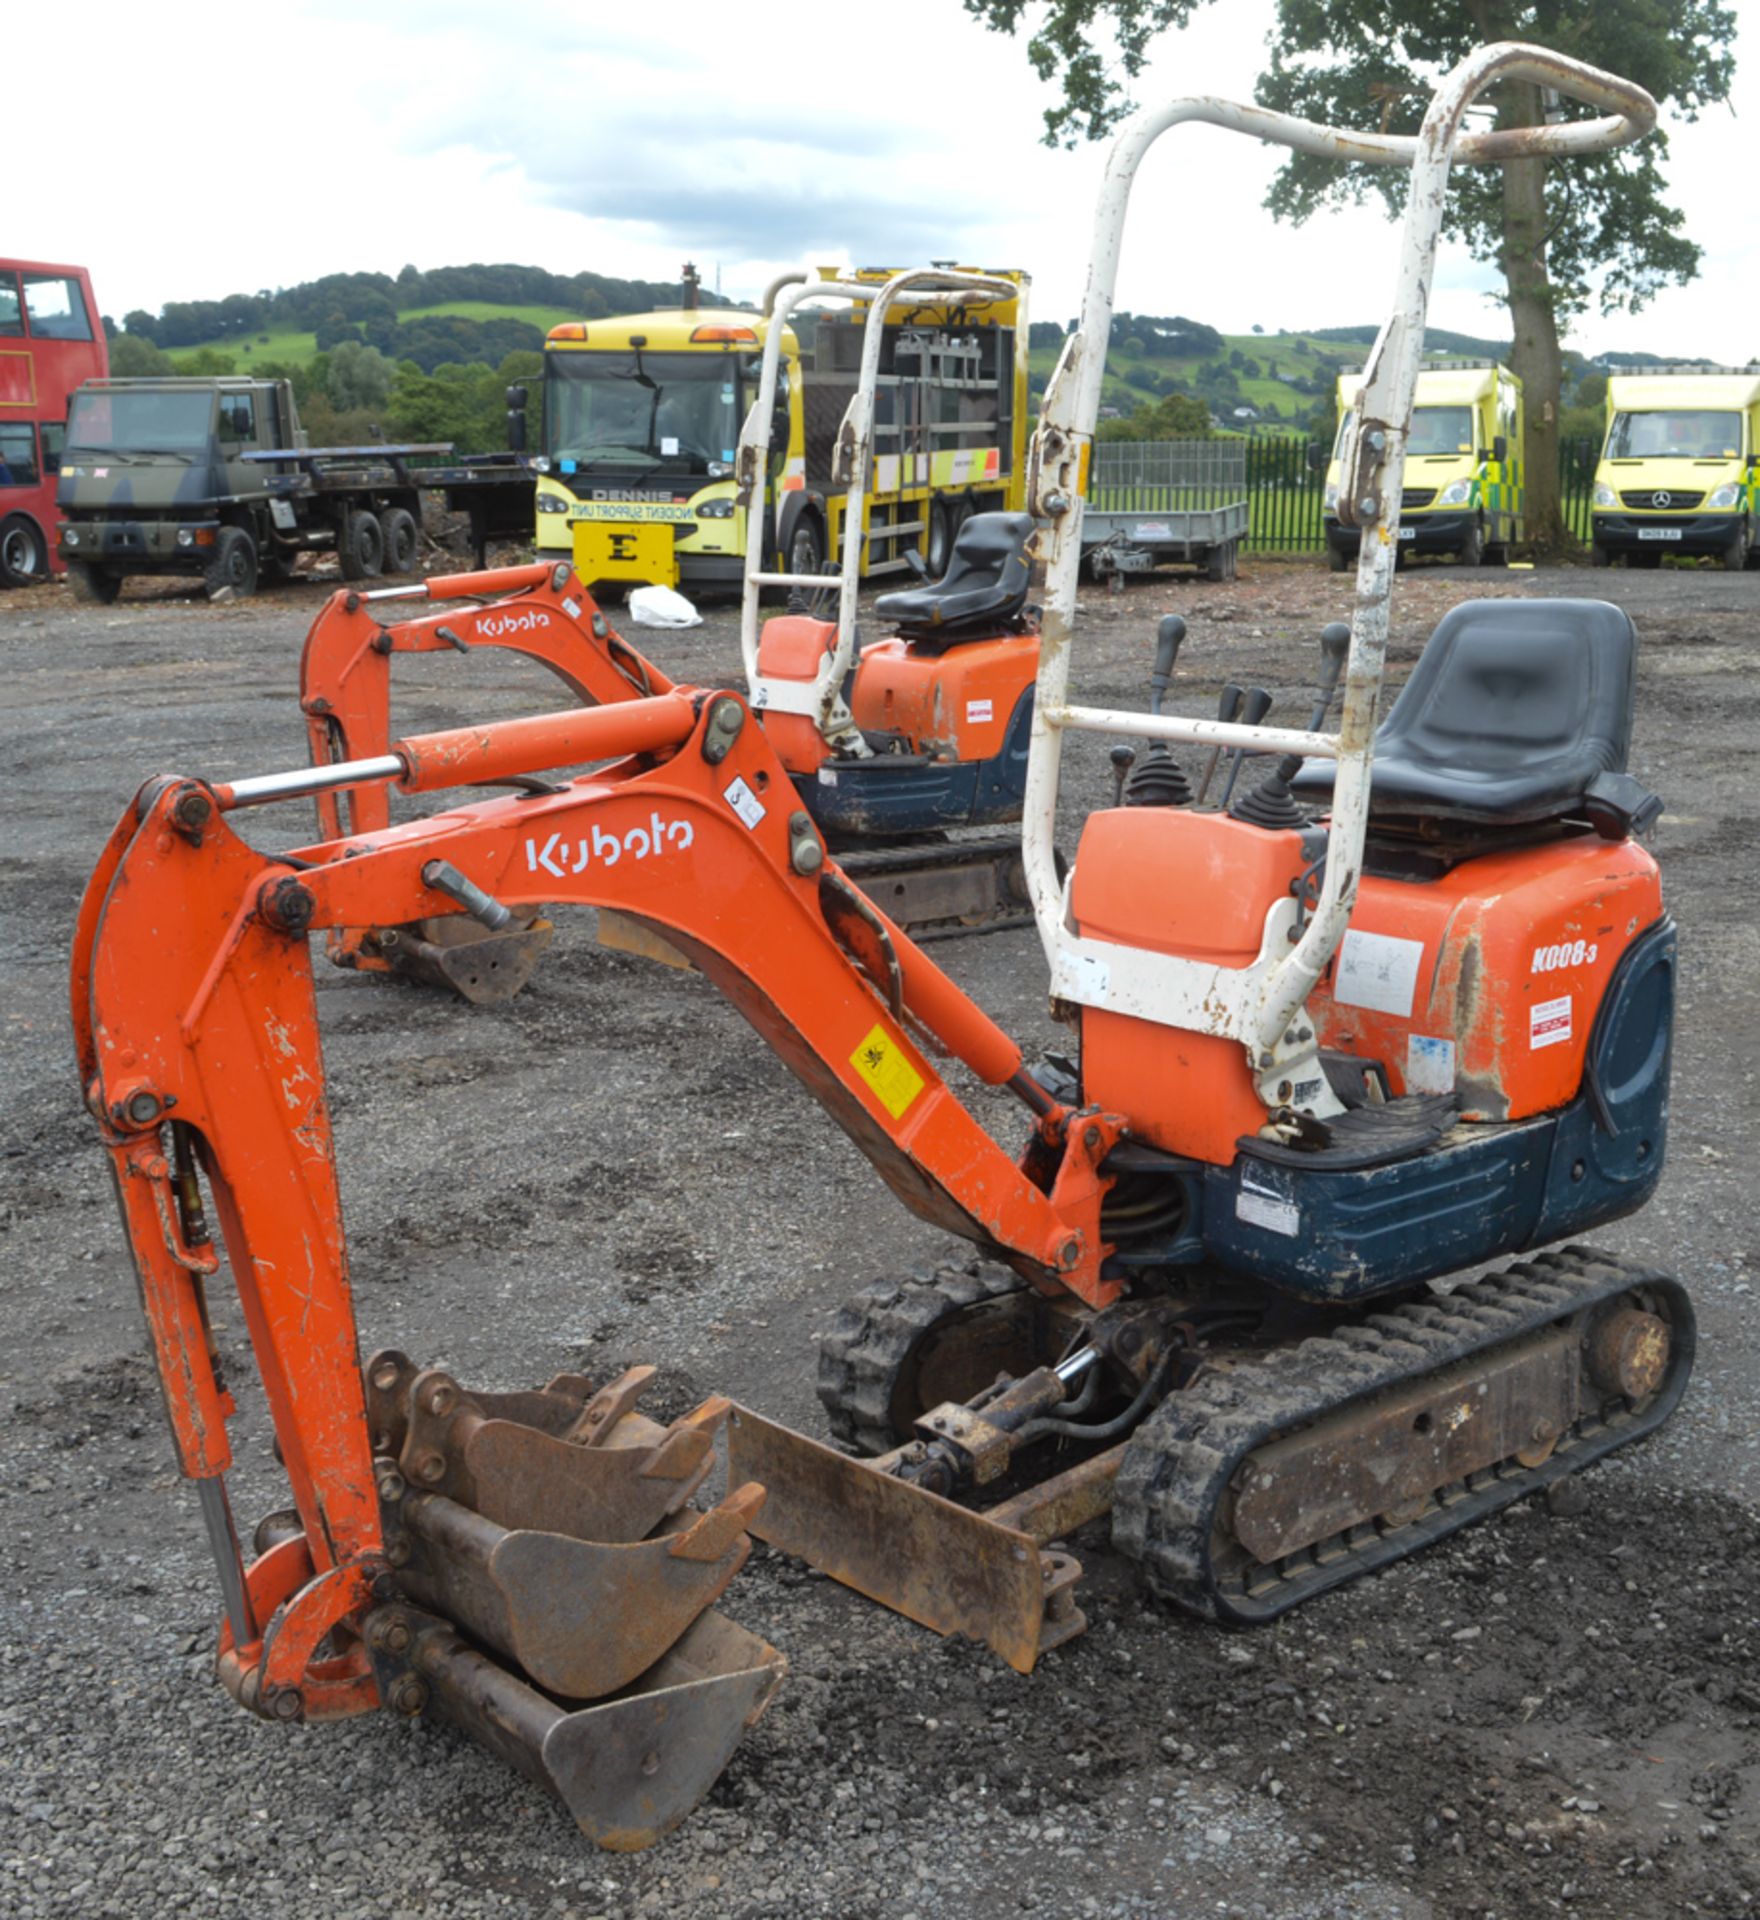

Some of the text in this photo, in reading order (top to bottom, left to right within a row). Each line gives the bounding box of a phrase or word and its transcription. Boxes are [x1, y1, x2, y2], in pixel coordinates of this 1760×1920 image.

[592, 489, 673, 503] DENNIS
[476, 610, 550, 637] Kubota
[525, 812, 694, 878] Kubota
[1530, 939, 1598, 973] K008-3
